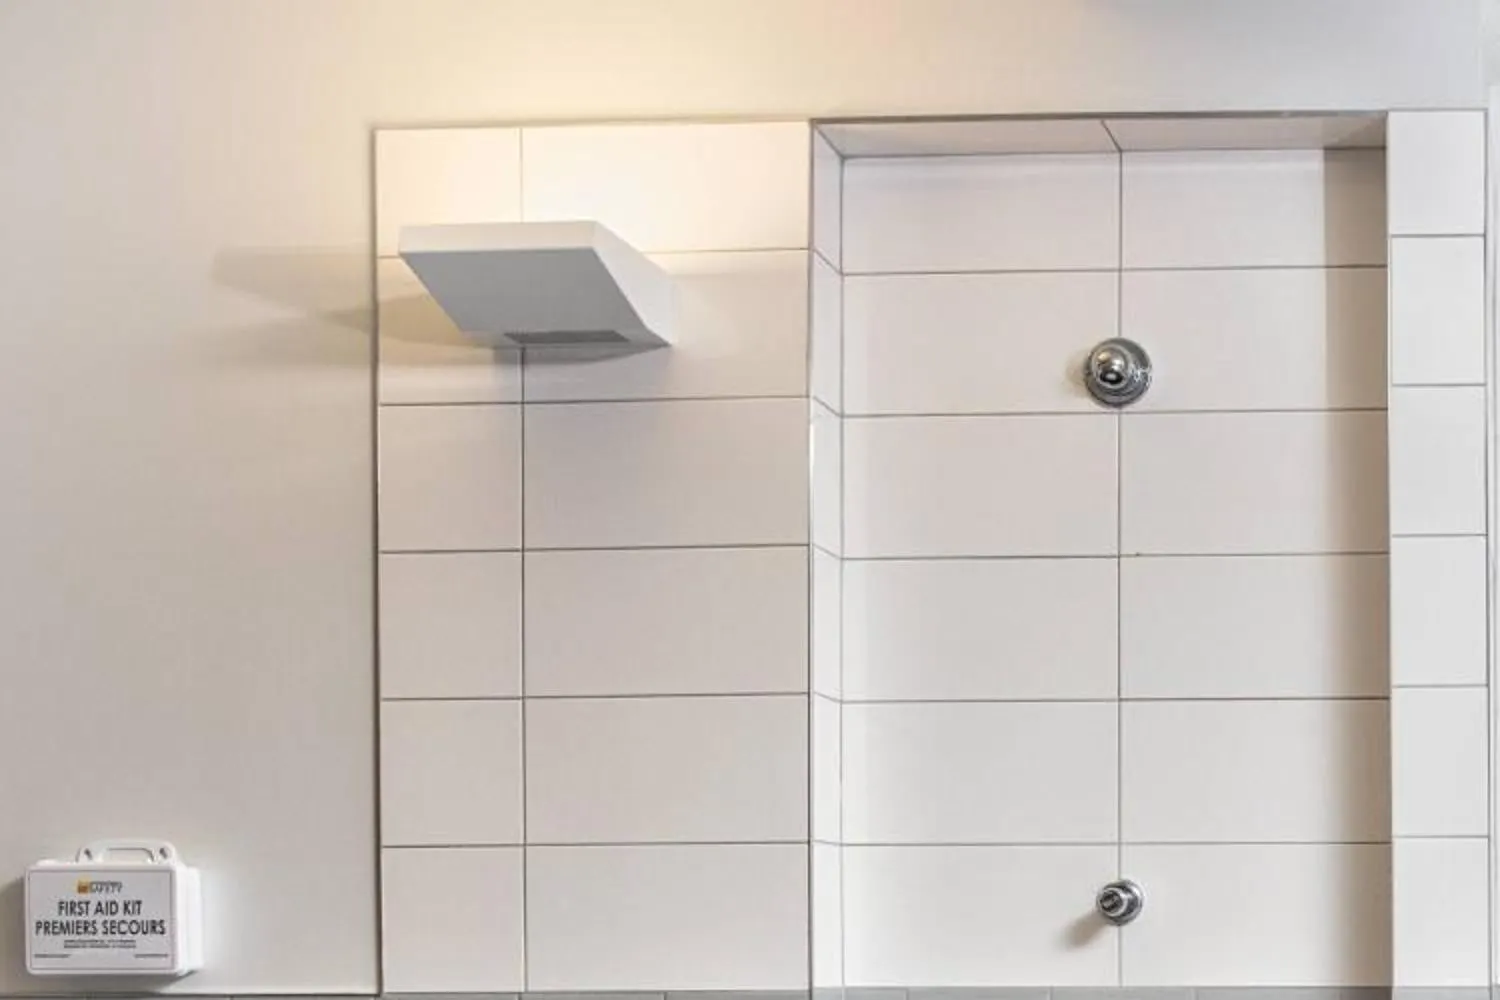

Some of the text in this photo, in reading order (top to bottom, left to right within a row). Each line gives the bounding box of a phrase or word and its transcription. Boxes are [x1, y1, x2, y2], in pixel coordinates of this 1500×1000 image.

[57, 900, 142, 916] FIRST AID KIT
[35, 919, 166, 936] PREMIERS SECOURS
